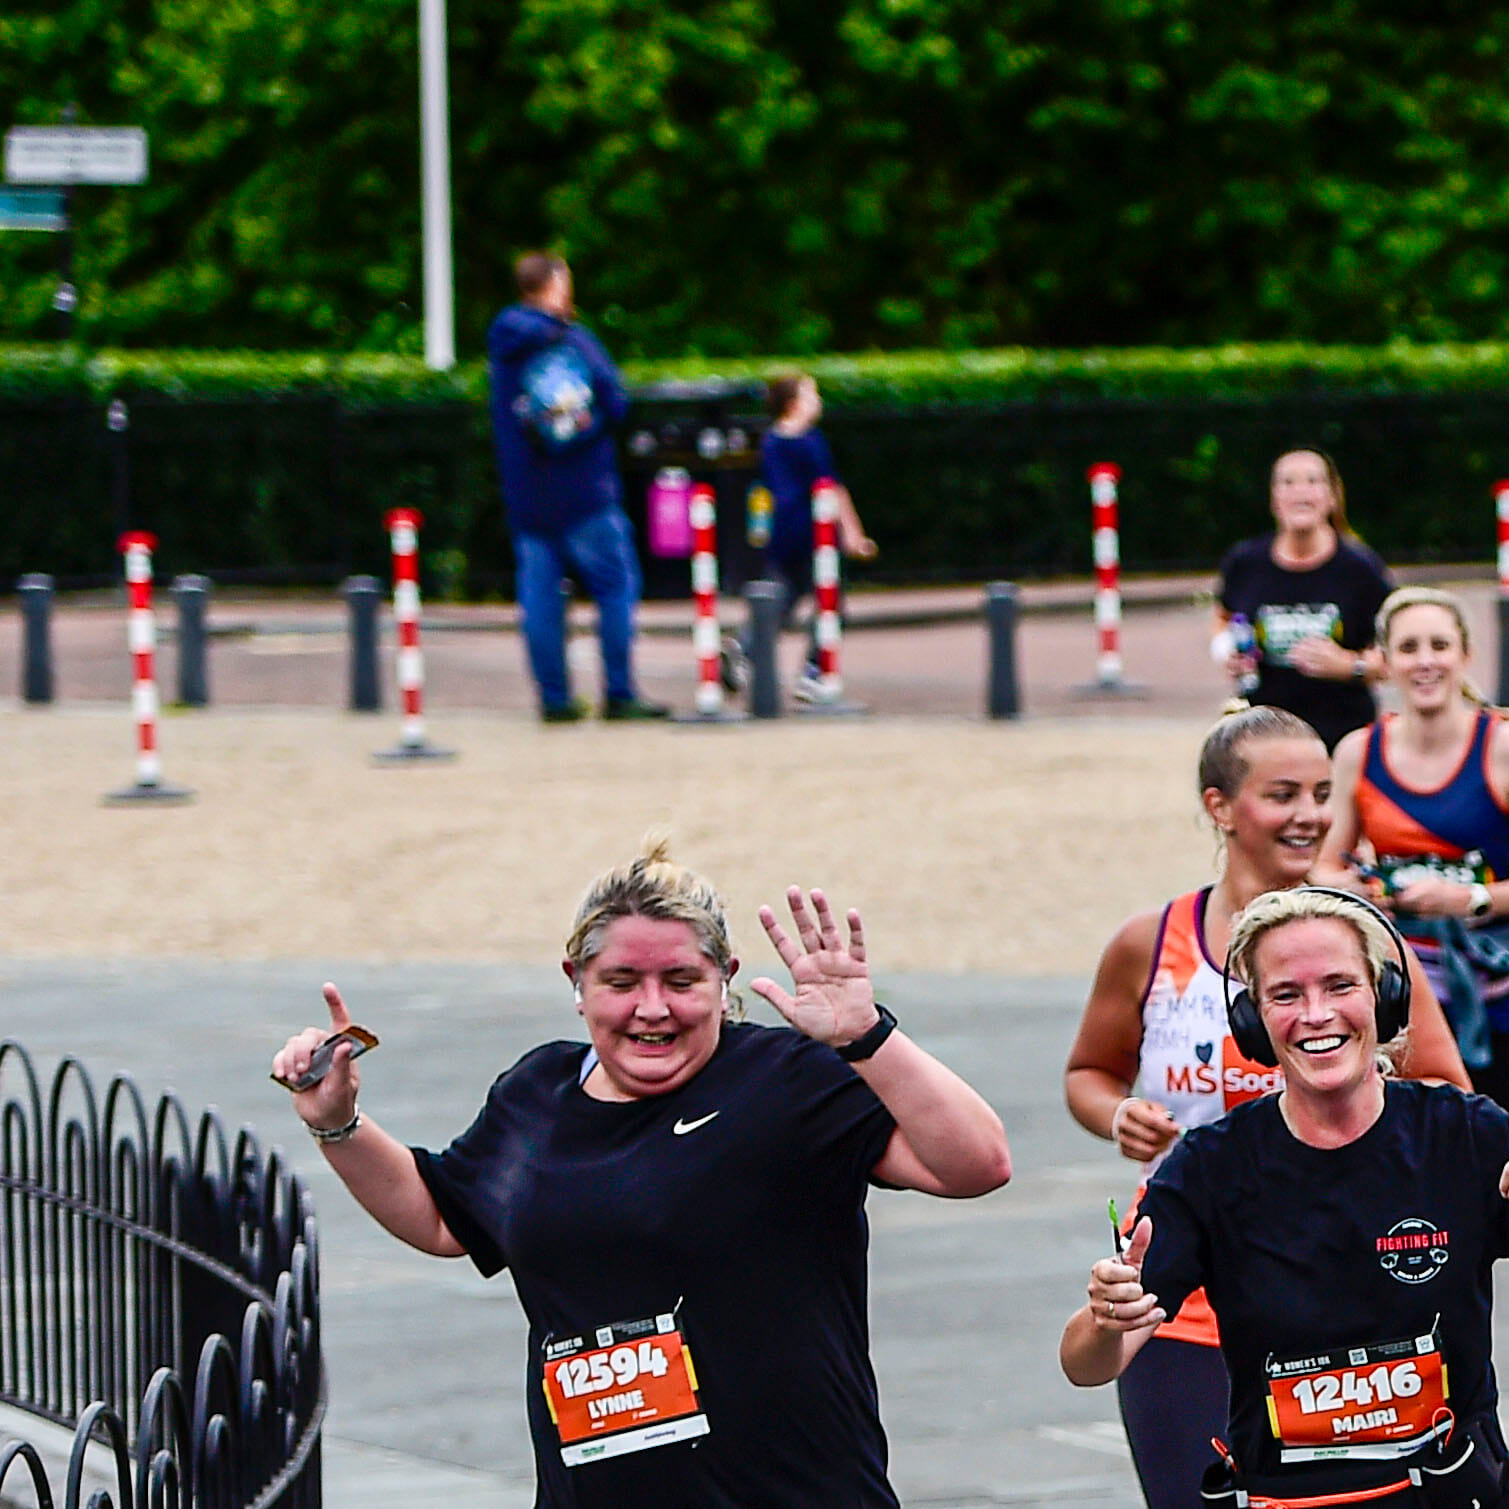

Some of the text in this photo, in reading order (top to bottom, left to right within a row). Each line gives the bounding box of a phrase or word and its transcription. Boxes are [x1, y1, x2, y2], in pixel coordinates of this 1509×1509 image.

[1166, 1064, 1287, 1094] MS Soci
[1376, 1231, 1449, 1252] FIGHTING FIT
[555, 1342, 668, 1399] 12594
[1292, 1361, 1422, 1414] 12416
[588, 1389, 645, 1419] LYNNE
[1332, 1407, 1398, 1434] MAIRI
